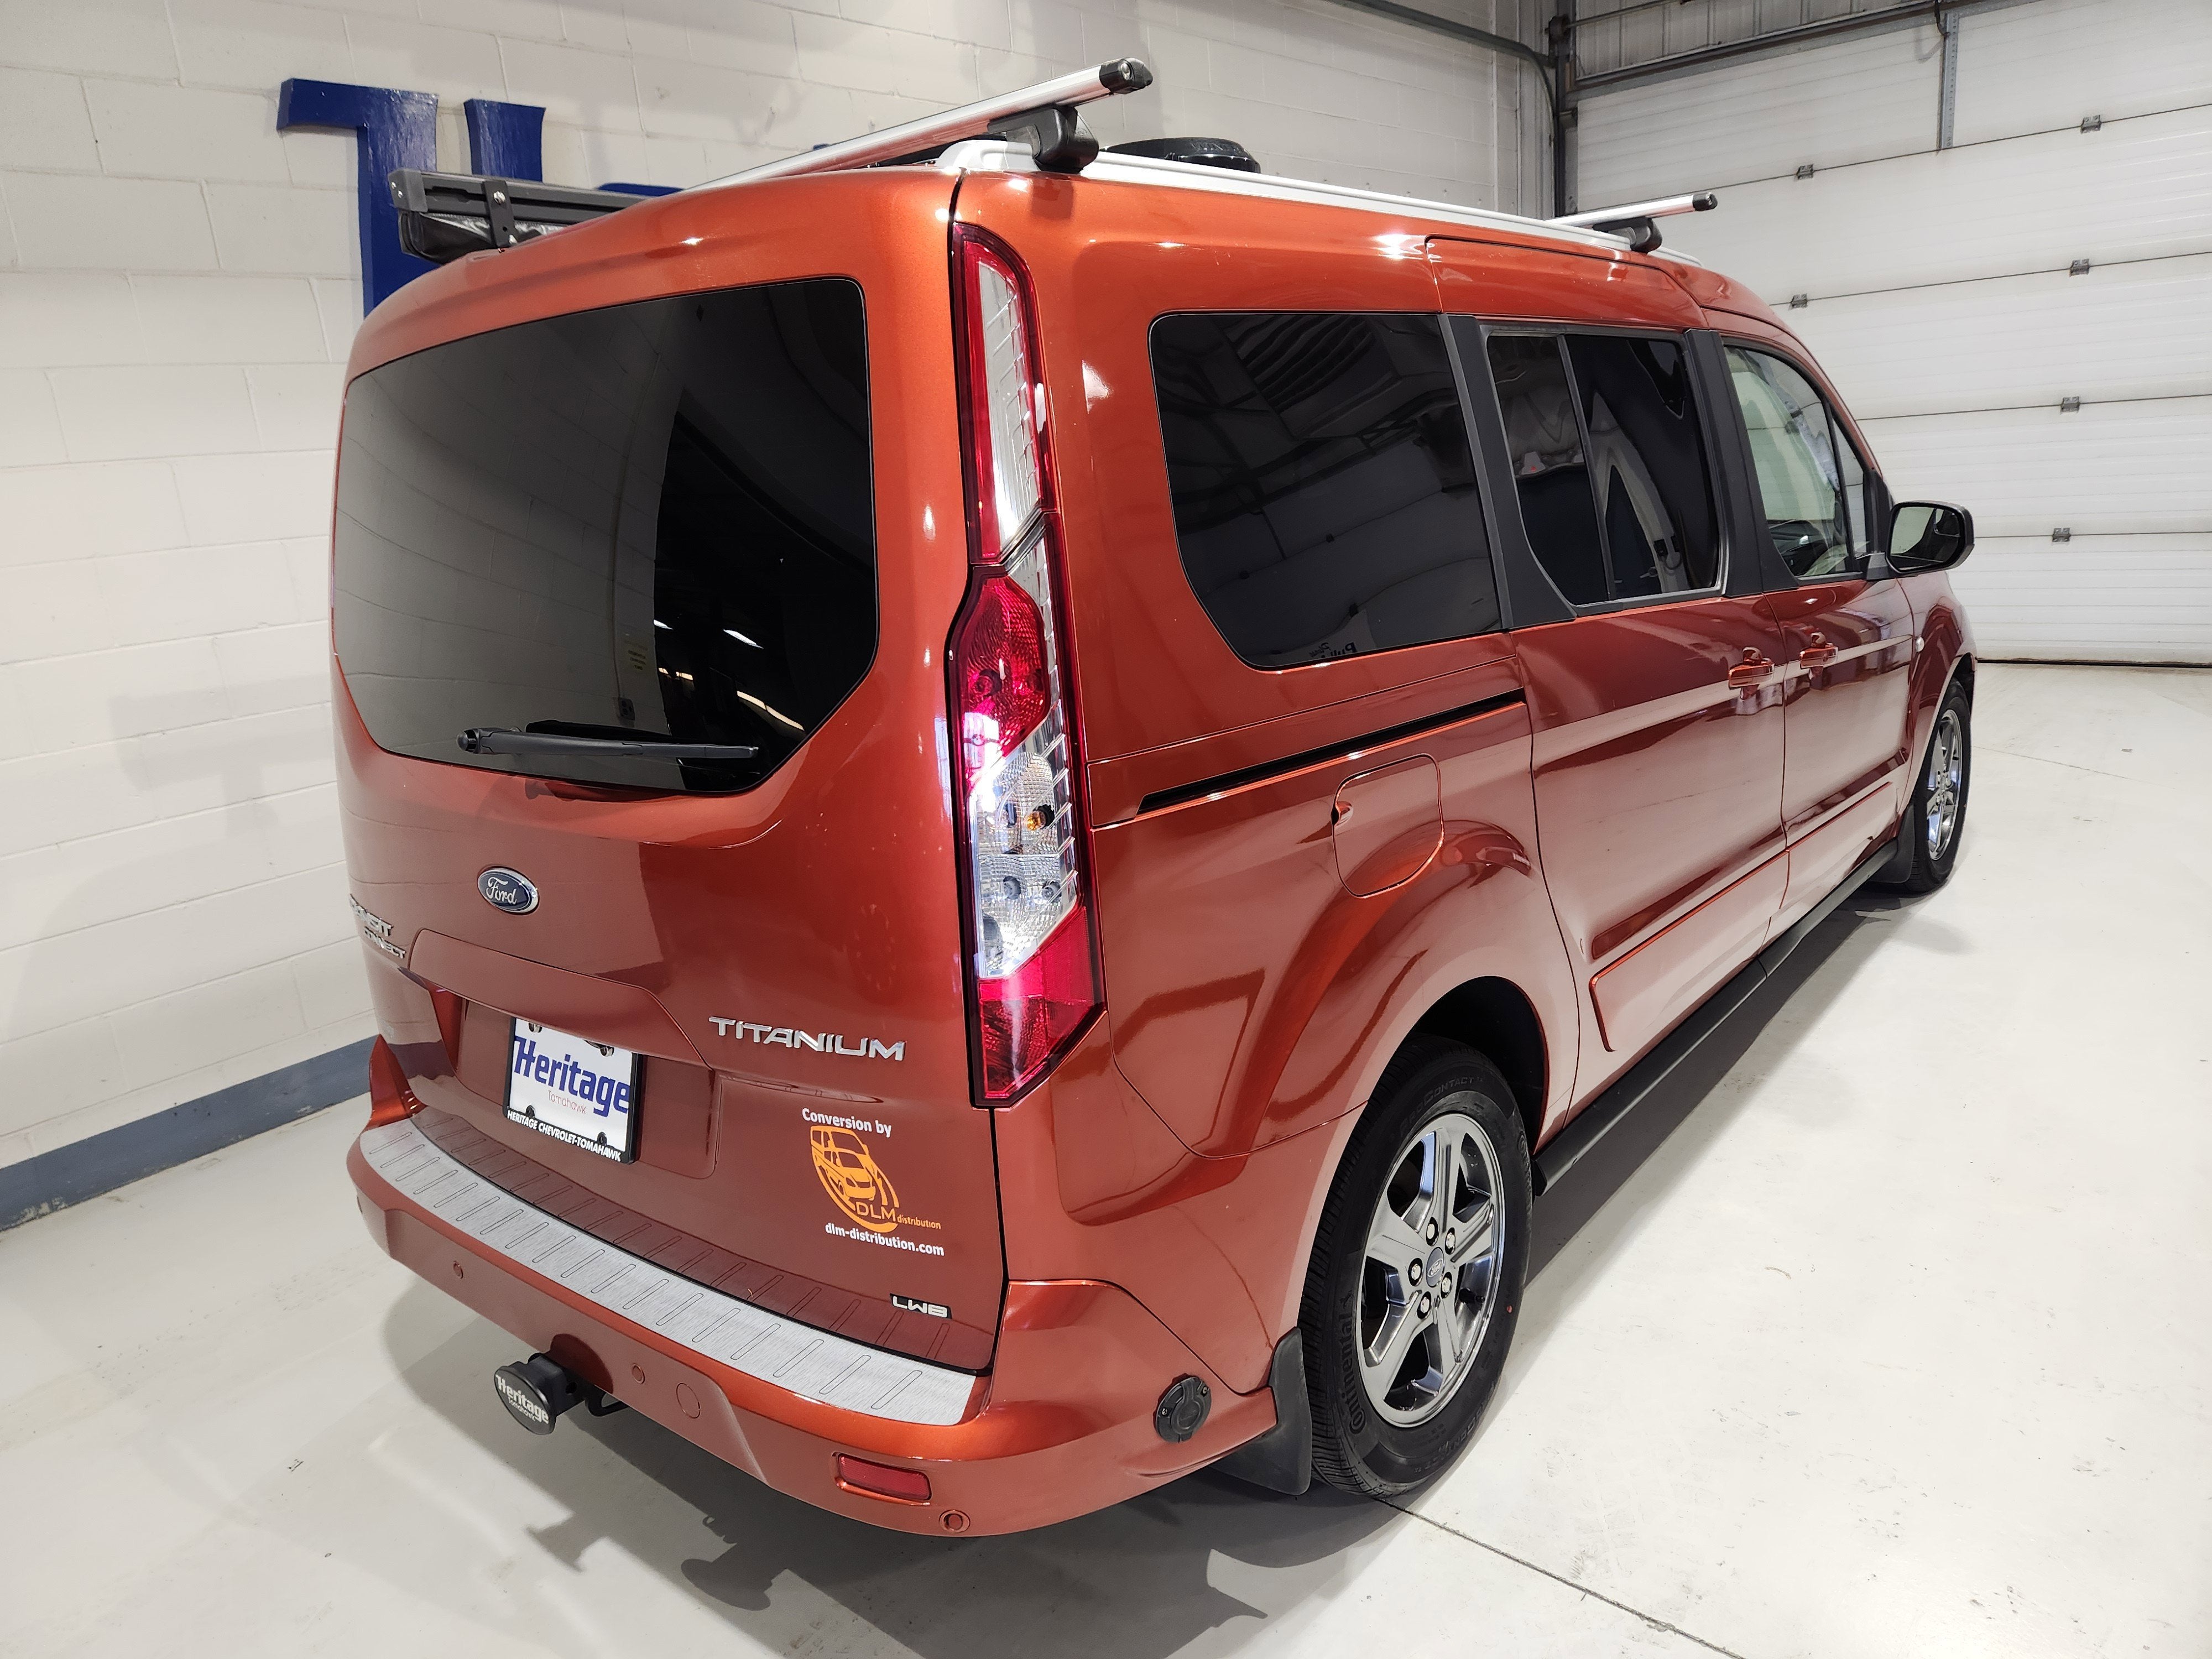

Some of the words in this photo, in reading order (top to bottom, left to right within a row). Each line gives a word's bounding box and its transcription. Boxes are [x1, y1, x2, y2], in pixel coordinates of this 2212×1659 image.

[486, 876, 518, 905] Ford
[364, 926, 407, 959] CONNECT
[708, 1016, 906, 1061] TITANIUM
[514, 1035, 630, 1118] Heritage
[547, 1090, 587, 1115] Tomahawk
[507, 1110, 538, 1130] HERITAGE
[802, 1108, 873, 1132] Conversion
[875, 1120, 892, 1138] by
[855, 1201, 896, 1223] DLM
[896, 1214, 942, 1230] distribution
[825, 1223, 945, 1256] dlm-distribution.com
[893, 1296, 948, 1318] LWB
[1338, 1313, 1366, 1435] Continental
[495, 1374, 549, 1425] Heritage
